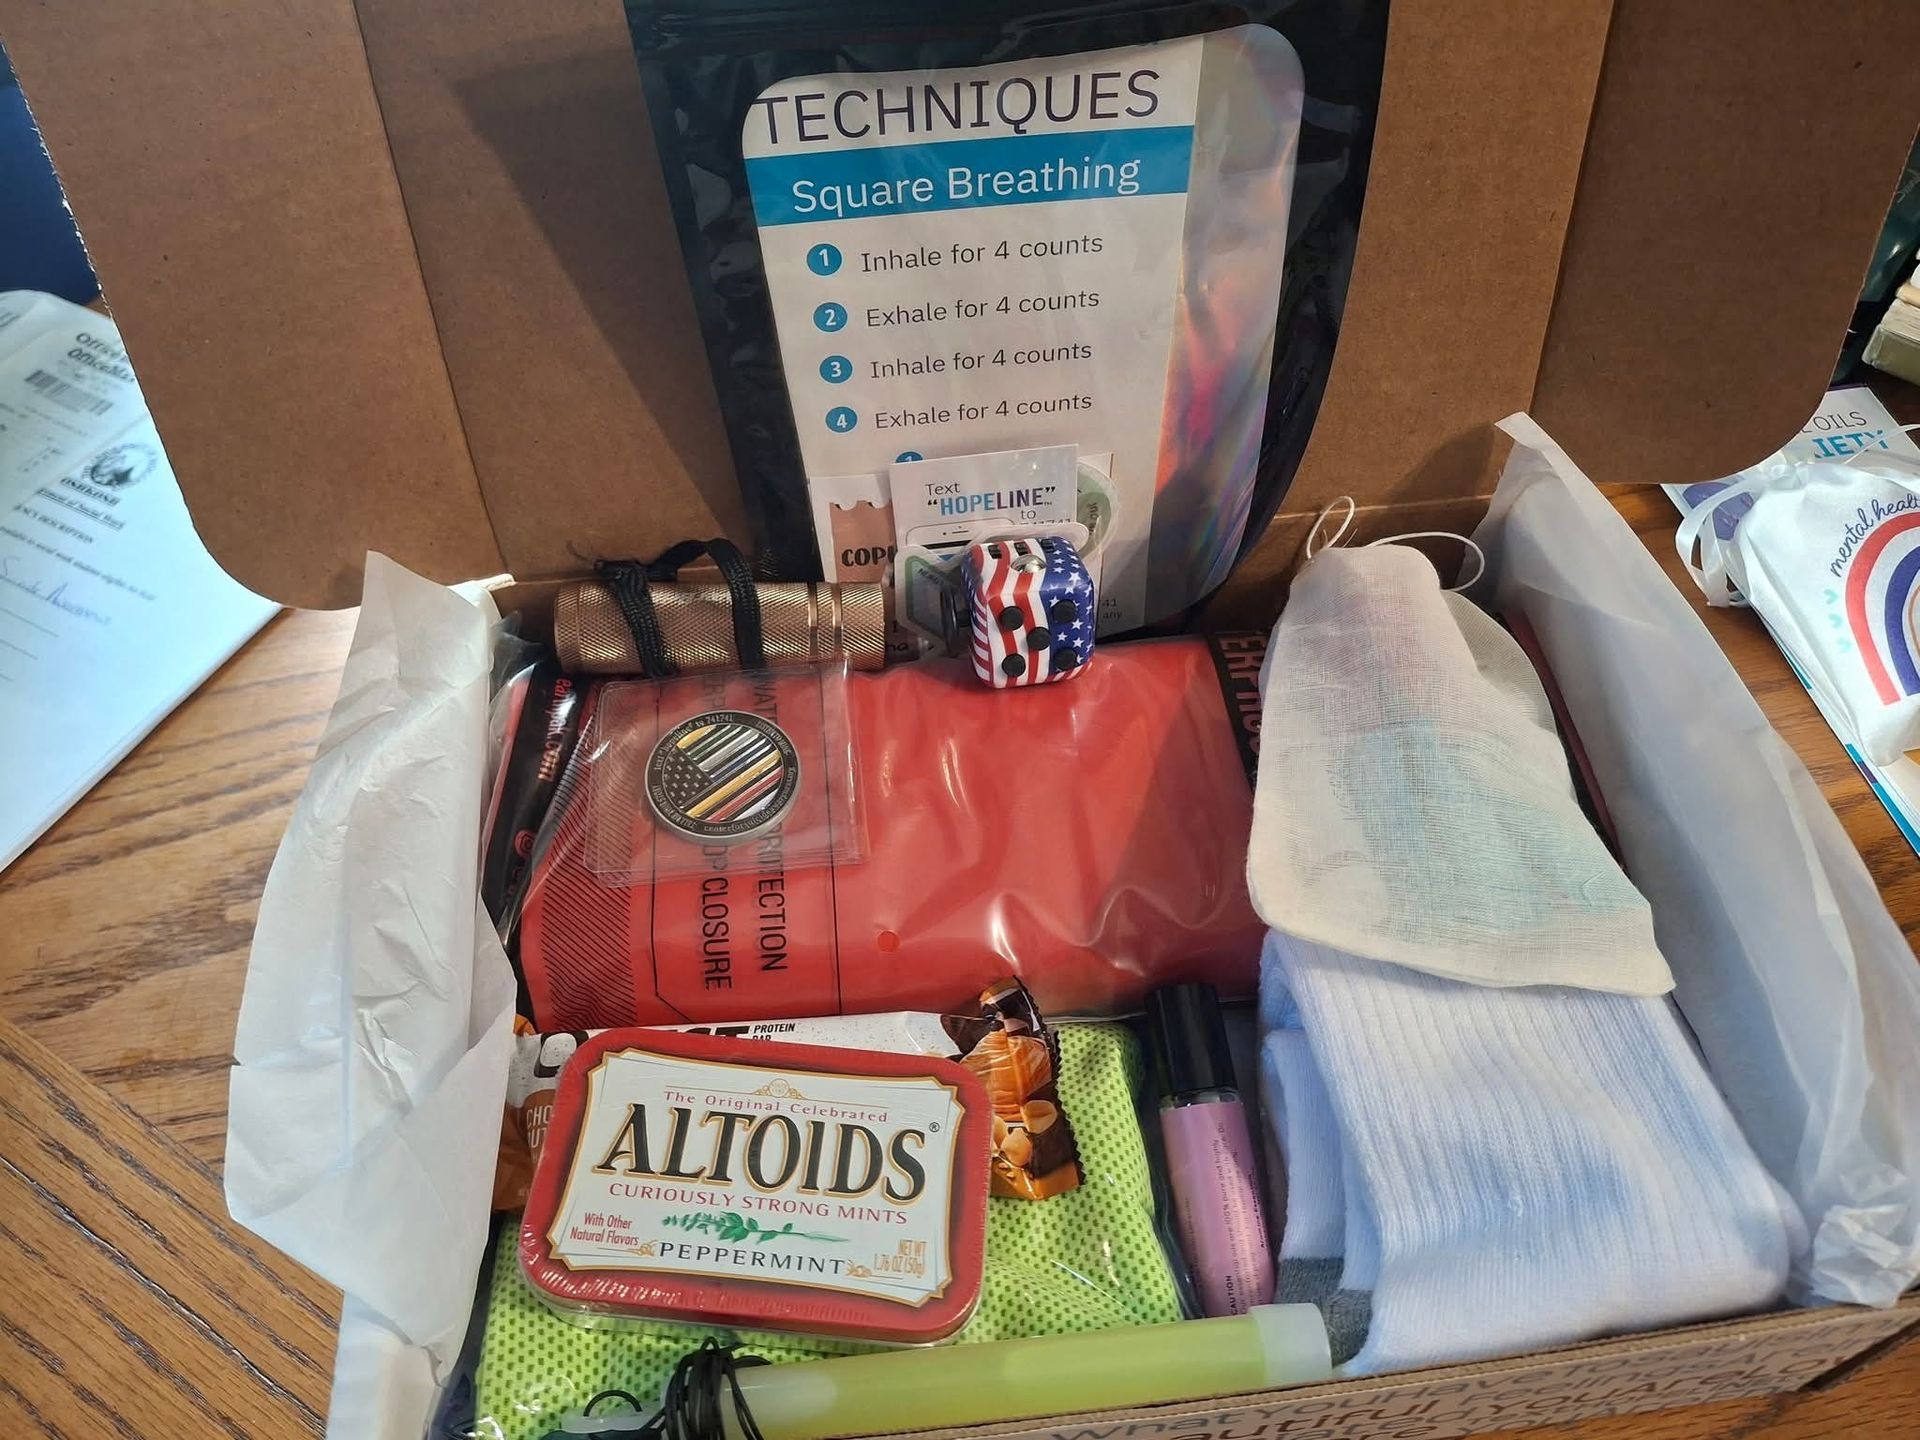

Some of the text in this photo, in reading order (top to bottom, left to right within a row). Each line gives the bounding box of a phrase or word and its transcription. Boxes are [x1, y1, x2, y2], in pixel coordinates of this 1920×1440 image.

[756, 69, 1160, 144] TECHNIQUES
[793, 157, 1142, 217] Square Breathing
[861, 248, 942, 273] Inhale
[952, 244, 986, 266] for
[994, 240, 1010, 261] 4
[1019, 234, 1104, 259] counts
[866, 302, 948, 328] Exhale
[955, 298, 989, 319] for
[996, 295, 1012, 316] 4
[1018, 289, 1100, 314] counts
[870, 354, 946, 380] Inhale
[953, 350, 986, 373] for
[992, 347, 1008, 368] 4
[1014, 342, 1092, 365] counts
[874, 405, 952, 430] Exhale
[957, 401, 990, 422] for
[995, 398, 1010, 418] 4
[1015, 393, 1093, 416] counts
[1813, 411, 1867, 431] OILS
[1812, 430, 1889, 459] IETY
[925, 483, 961, 496] Text
[1020, 510, 1037, 520] to
[1830, 508, 1874, 578] mental
[702, 877, 732, 990] CLOSURE
[753, 1022, 796, 1034] PROTEIN
[664, 1090, 889, 1123] The Original Celebrated
[594, 1102, 929, 1205] ALTOIDS
[584, 1212, 633, 1230] With Other
[609, 1182, 908, 1225] CURIOUSLY STRONG MINTS
[569, 1226, 639, 1248] Natural Flavors
[658, 1241, 846, 1276] PEPPERMINT
[1224, 1274, 1237, 1316] CAUTION
